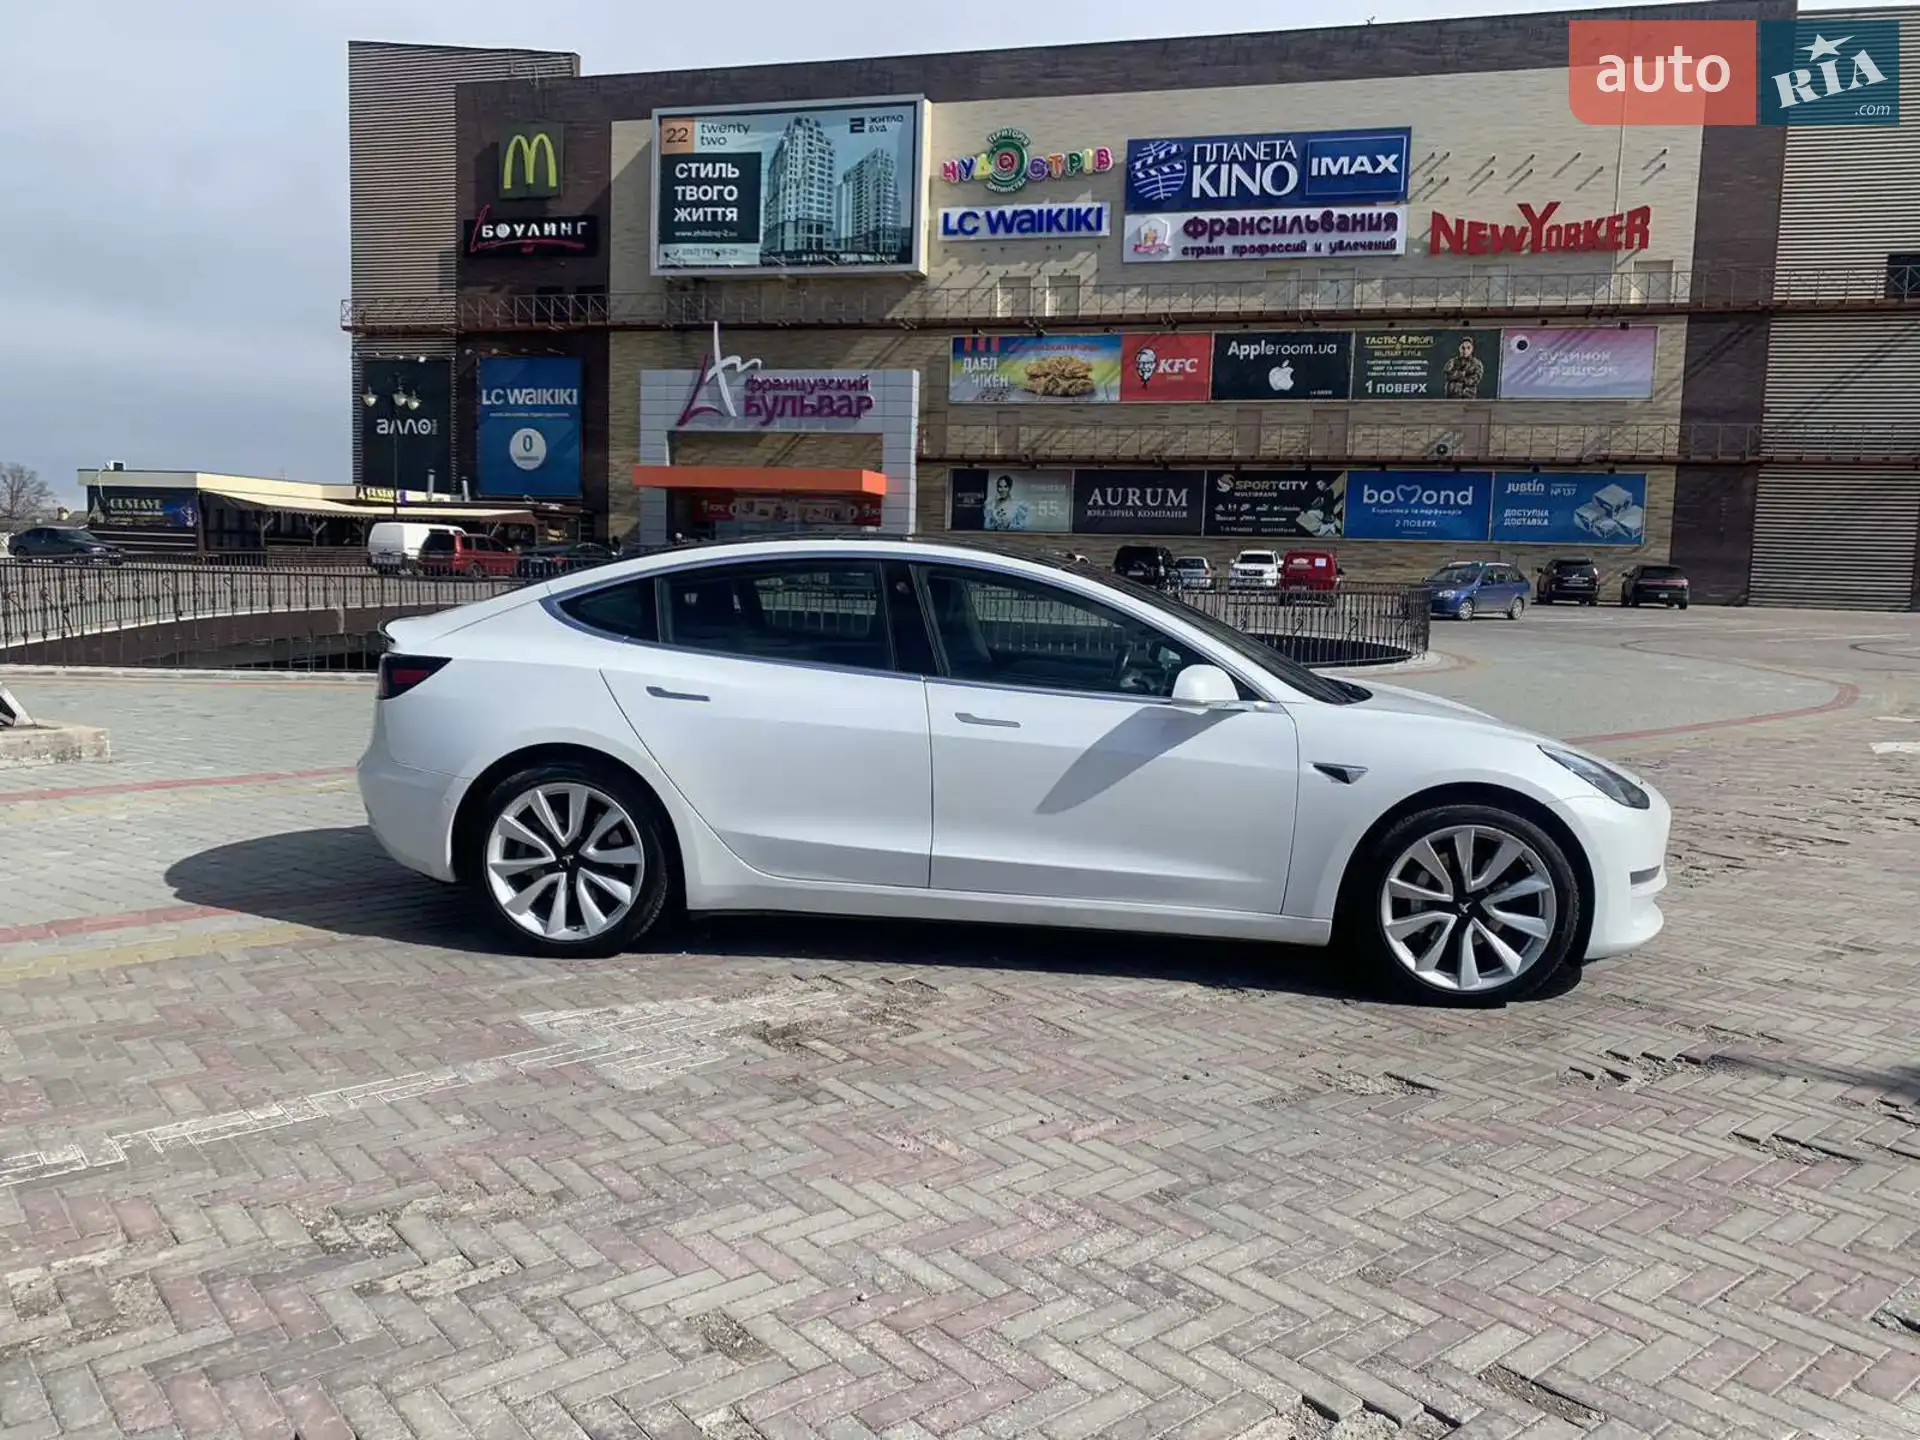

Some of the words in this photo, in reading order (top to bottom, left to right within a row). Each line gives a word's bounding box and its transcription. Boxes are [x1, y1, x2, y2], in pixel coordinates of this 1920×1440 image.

[666, 127, 688, 143] 22
[701, 122, 750, 134] twenty
[701, 136, 727, 146] two
[674, 162, 740, 179] СТИЛЬ
[1310, 152, 1400, 177] IMAX
[1191, 160, 1300, 199] KINO
[673, 185, 739, 202] ТВОГО
[673, 207, 739, 222] ЖИТТЯ
[942, 210, 981, 236] LC
[481, 221, 588, 239] БОУЛИНГ
[1181, 245, 1225, 258] страна
[1231, 240, 1307, 257] профессий
[1314, 241, 1322, 252] и
[1364, 336, 1398, 344] TACTIC
[1227, 339, 1338, 360] Appleroom.ua
[962, 356, 998, 374] ДАБЛ
[1156, 358, 1199, 374] KFC
[971, 373, 1010, 389] ЧІКЕН
[1365, 380, 1373, 393] 1
[1376, 383, 1428, 393] ПОВЕРХ
[481, 388, 505, 406] LC
[1087, 487, 1189, 507] AURUM
